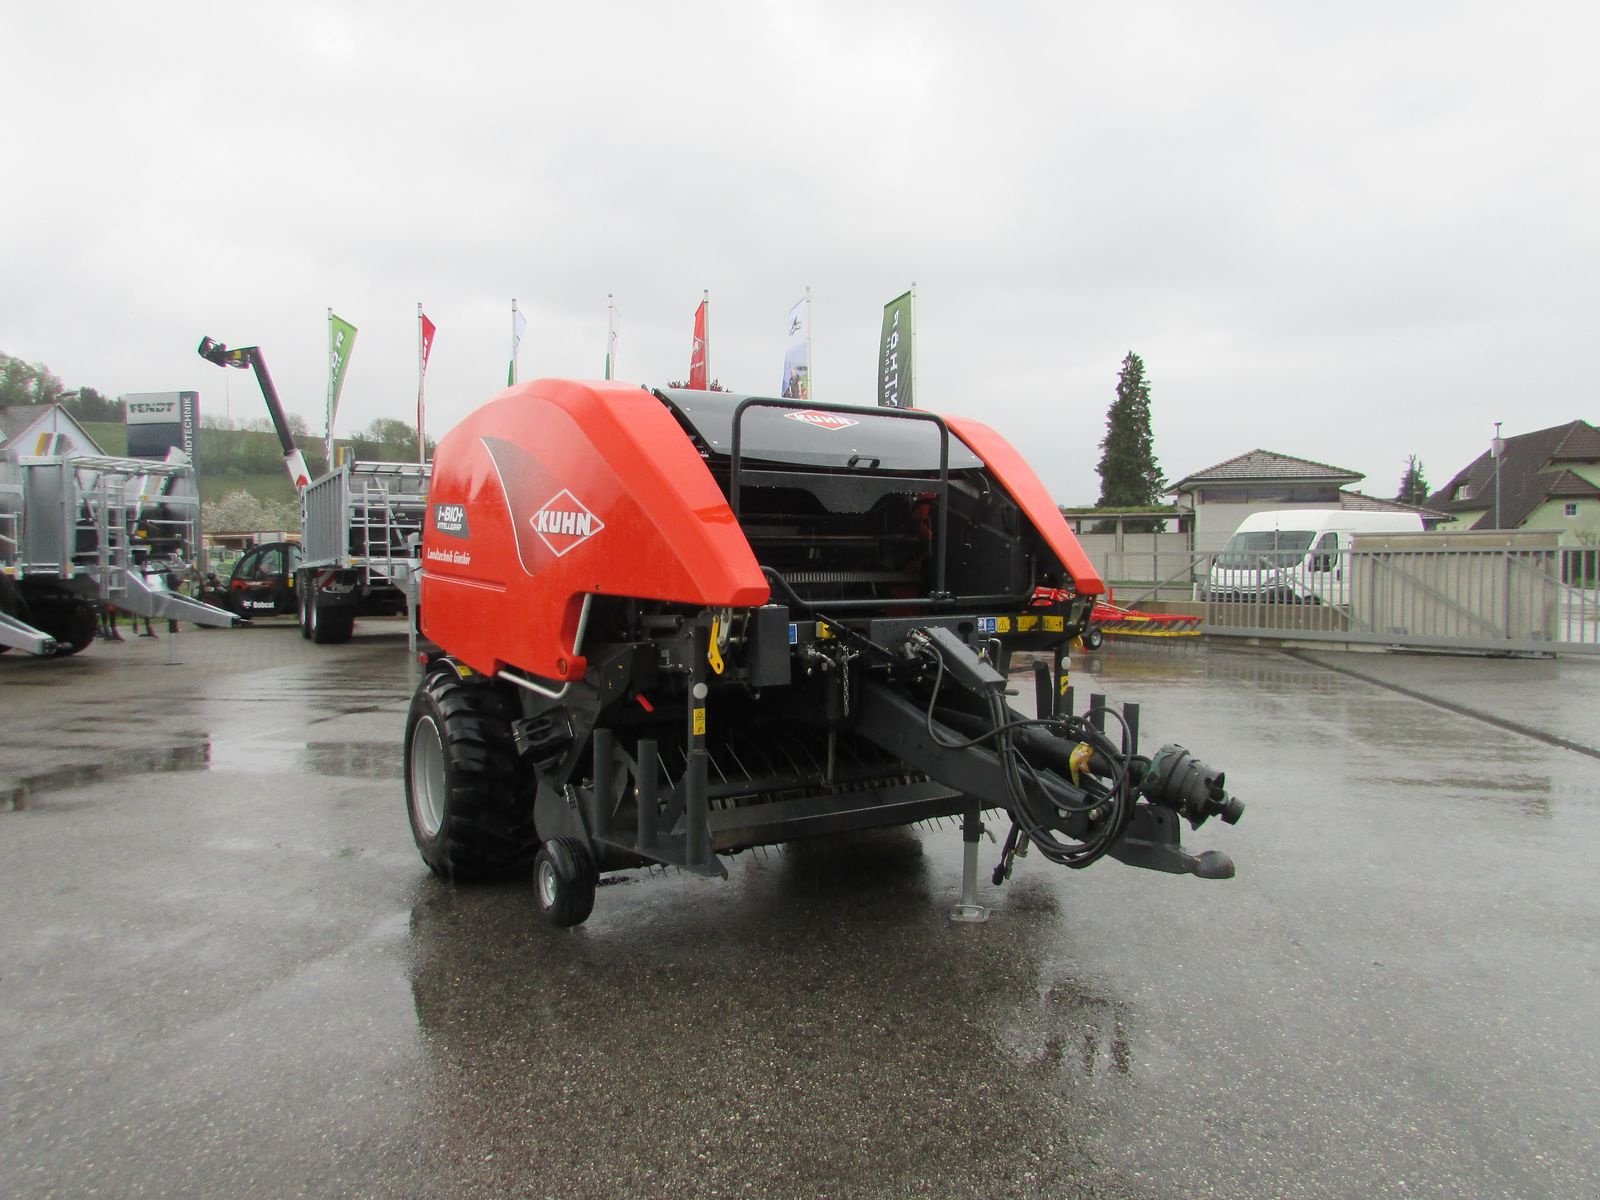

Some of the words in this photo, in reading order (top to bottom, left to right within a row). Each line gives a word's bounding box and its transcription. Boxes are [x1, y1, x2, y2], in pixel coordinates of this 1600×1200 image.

[129, 402, 176, 413] FENDT
[794, 413, 851, 425] KUHN
[537, 510, 593, 537] KUHN
[253, 601, 275, 609] Bobcat
